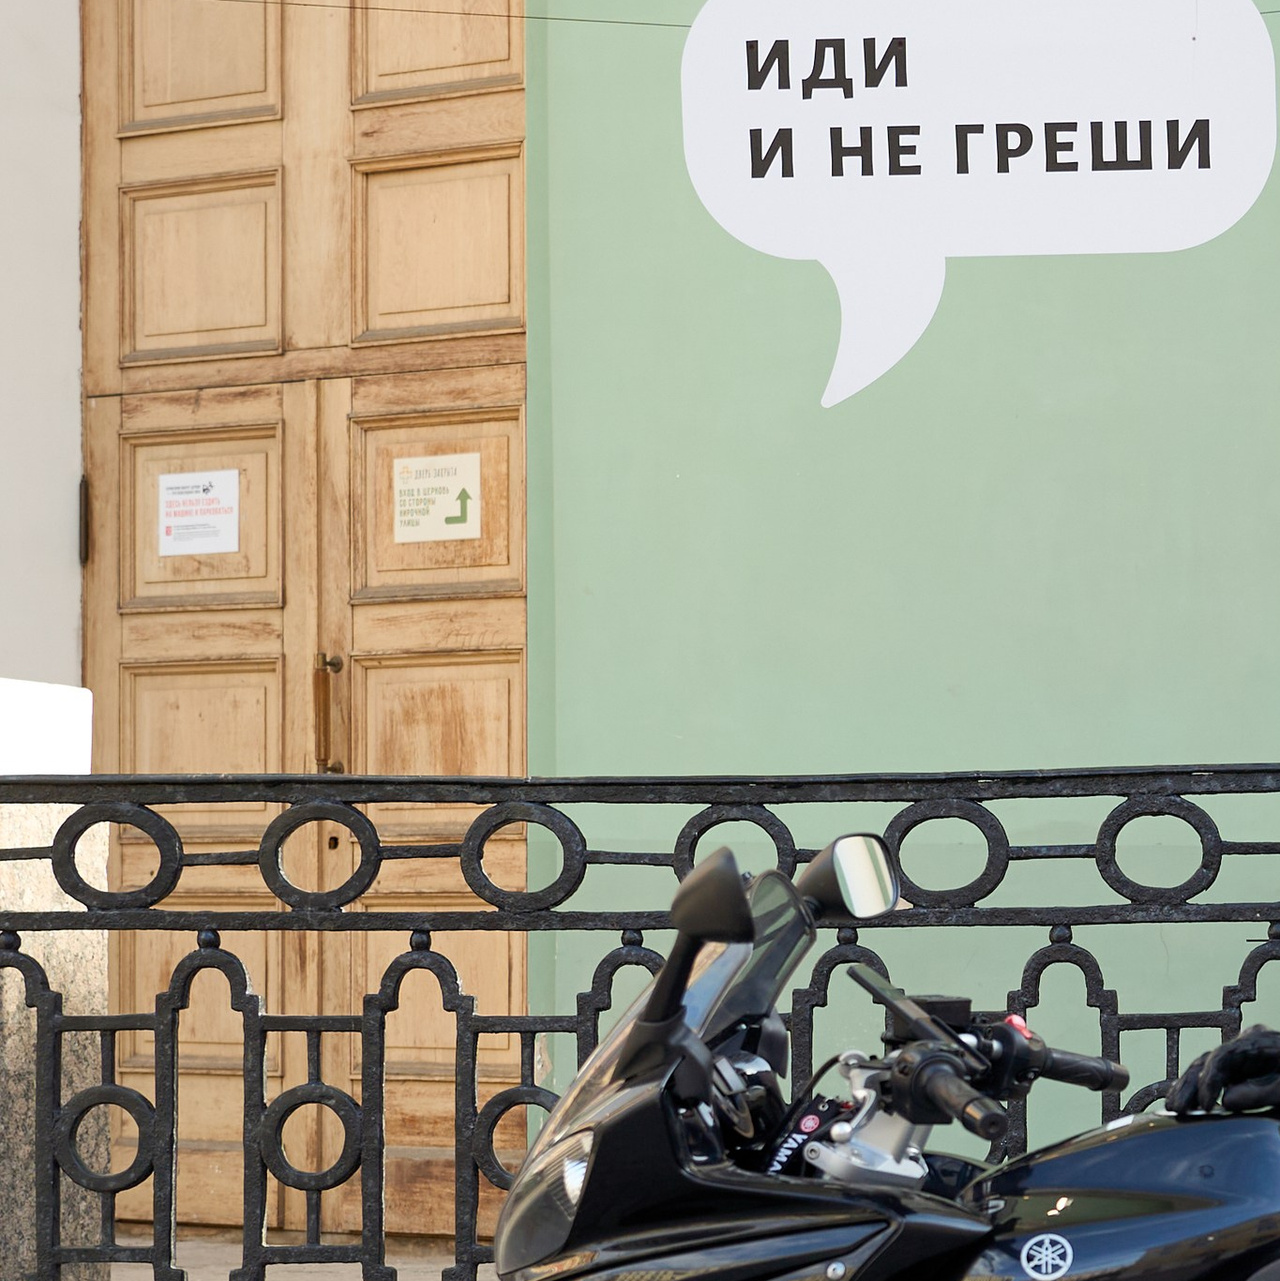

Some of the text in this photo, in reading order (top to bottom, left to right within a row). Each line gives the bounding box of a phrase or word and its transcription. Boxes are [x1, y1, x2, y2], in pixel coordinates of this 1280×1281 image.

[745, 37, 908, 100] ИДИ
[749, 118, 1211, 179] И НЕ ГРЕШИ
[766, 1132, 809, 1177] YAMA
